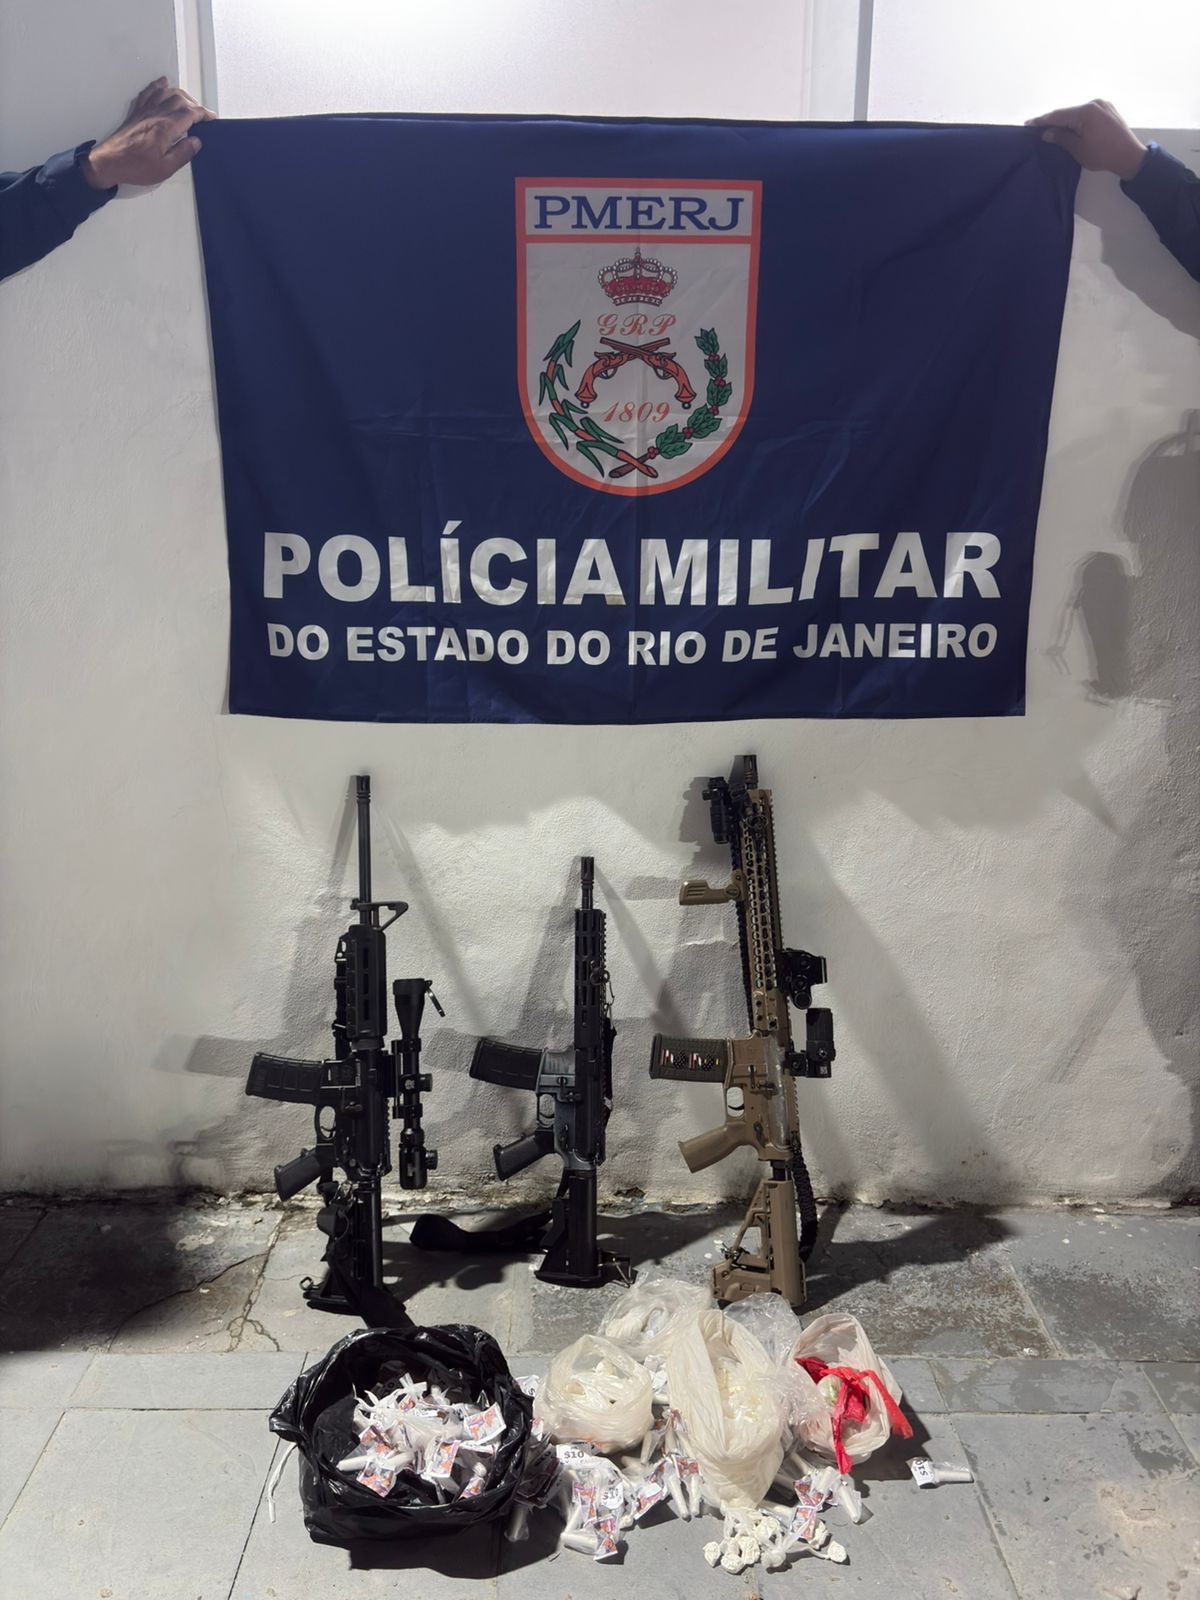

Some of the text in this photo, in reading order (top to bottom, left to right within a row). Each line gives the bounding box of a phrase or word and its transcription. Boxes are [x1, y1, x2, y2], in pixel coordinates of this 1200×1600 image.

[534, 195, 745, 231] PMERJ
[597, 313, 677, 336] GRP
[602, 401, 670, 422] 1809
[263, 520, 1001, 606] POLÍCIA MILITAR
[267, 622, 998, 666] DO ESTADO DO RIO DE JANEIRO
